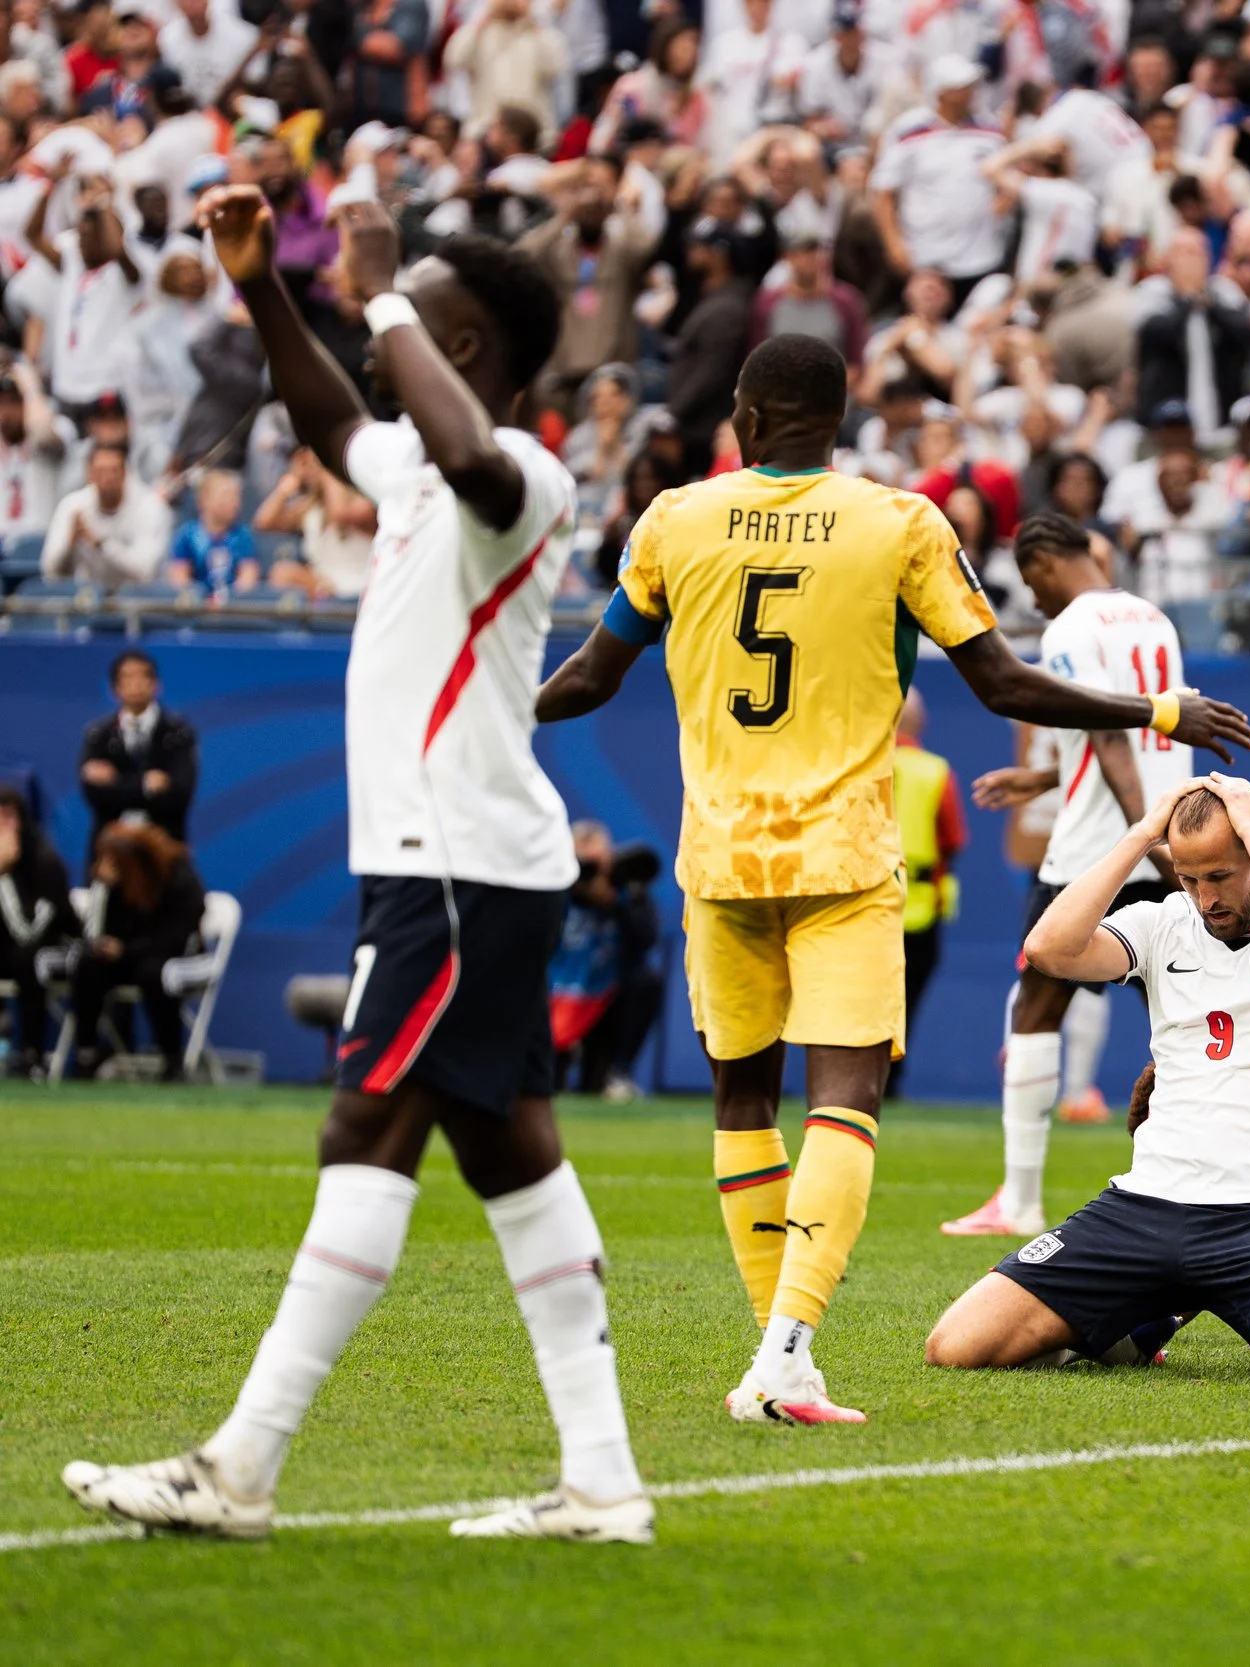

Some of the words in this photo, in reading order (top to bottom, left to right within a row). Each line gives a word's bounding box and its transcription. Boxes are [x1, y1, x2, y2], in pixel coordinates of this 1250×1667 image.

[727, 508, 836, 543] PARTEY
[727, 565, 814, 733] 5
[1205, 1010, 1234, 1060] 9
